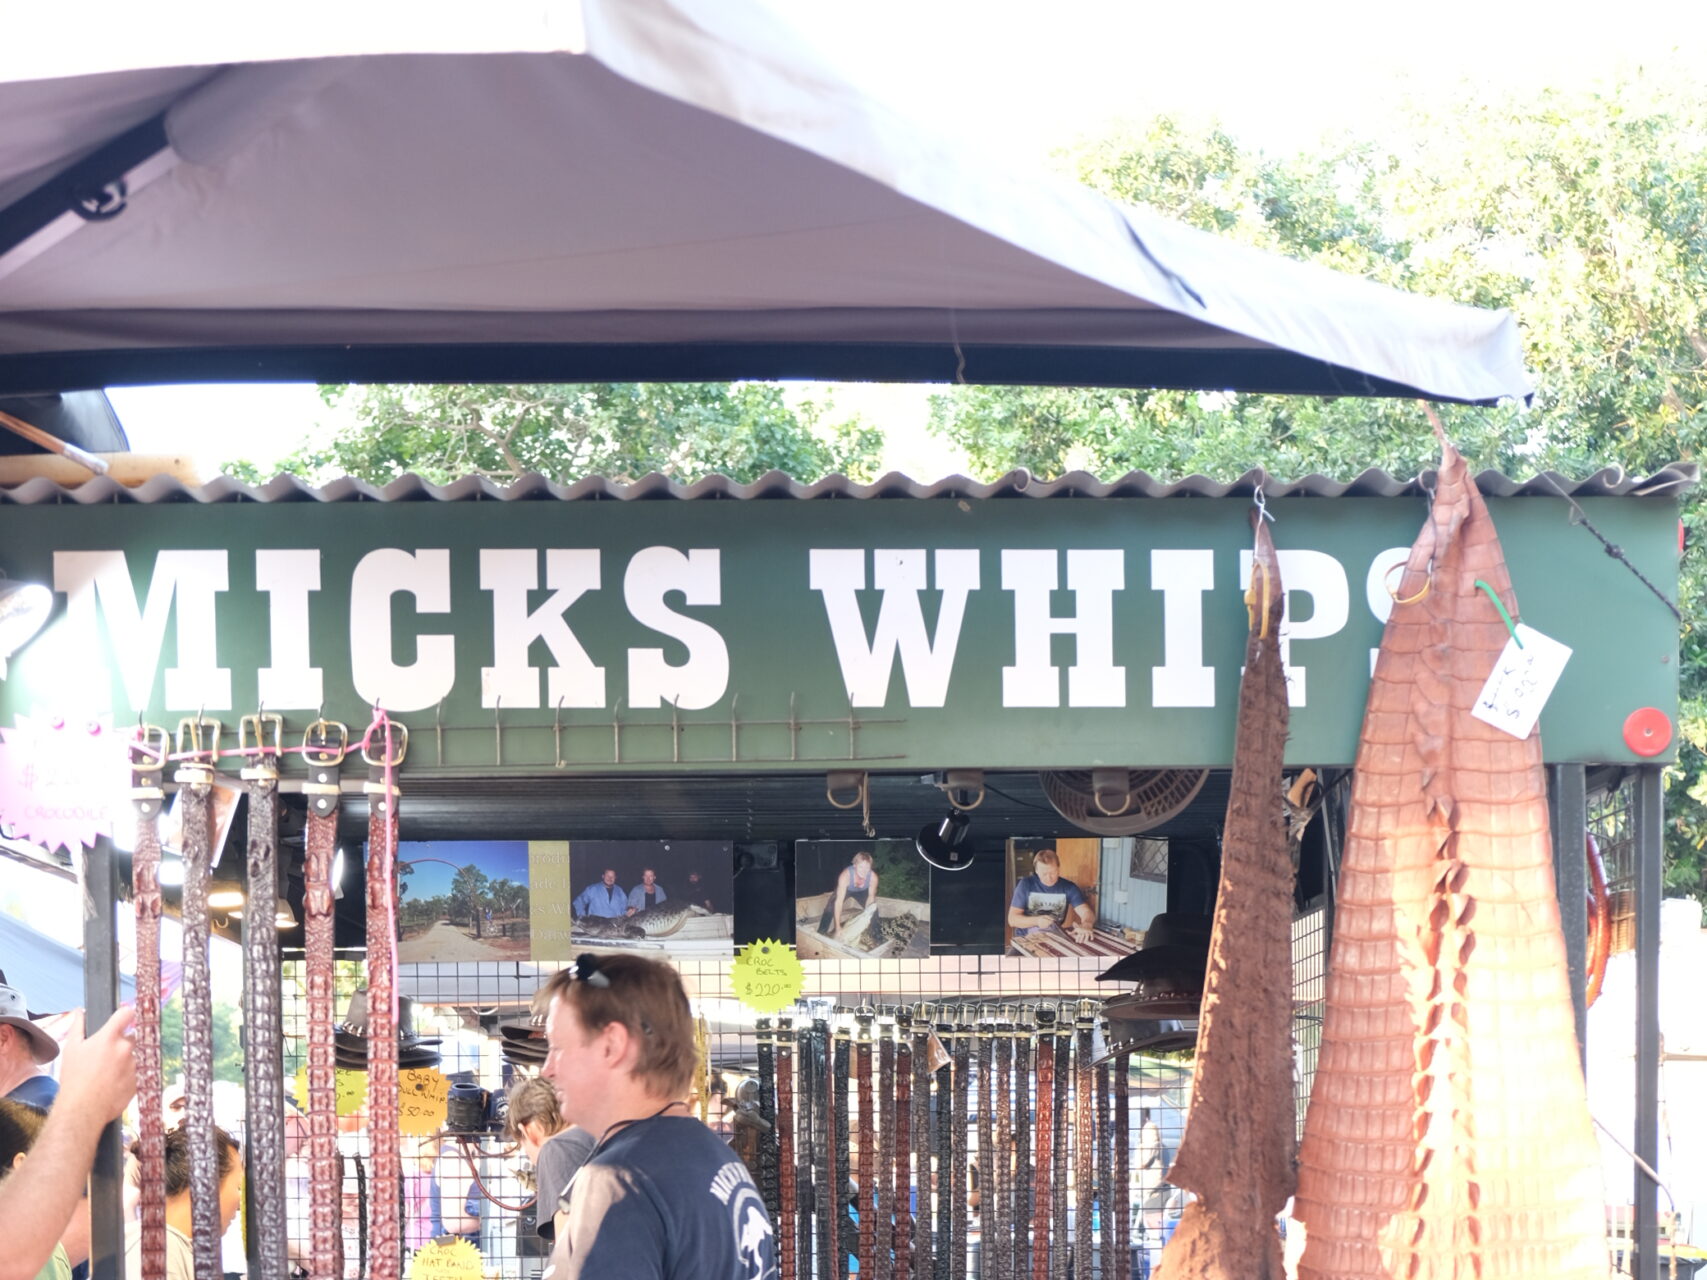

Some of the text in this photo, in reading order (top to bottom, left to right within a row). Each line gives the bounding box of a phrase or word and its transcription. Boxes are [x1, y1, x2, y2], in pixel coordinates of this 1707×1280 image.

[53, 545, 1412, 712] MICKS WHIP
[745, 957, 775, 967] CROC
[408, 1070, 439, 1091] BABY
[421, 1257, 443, 1268] HAT
